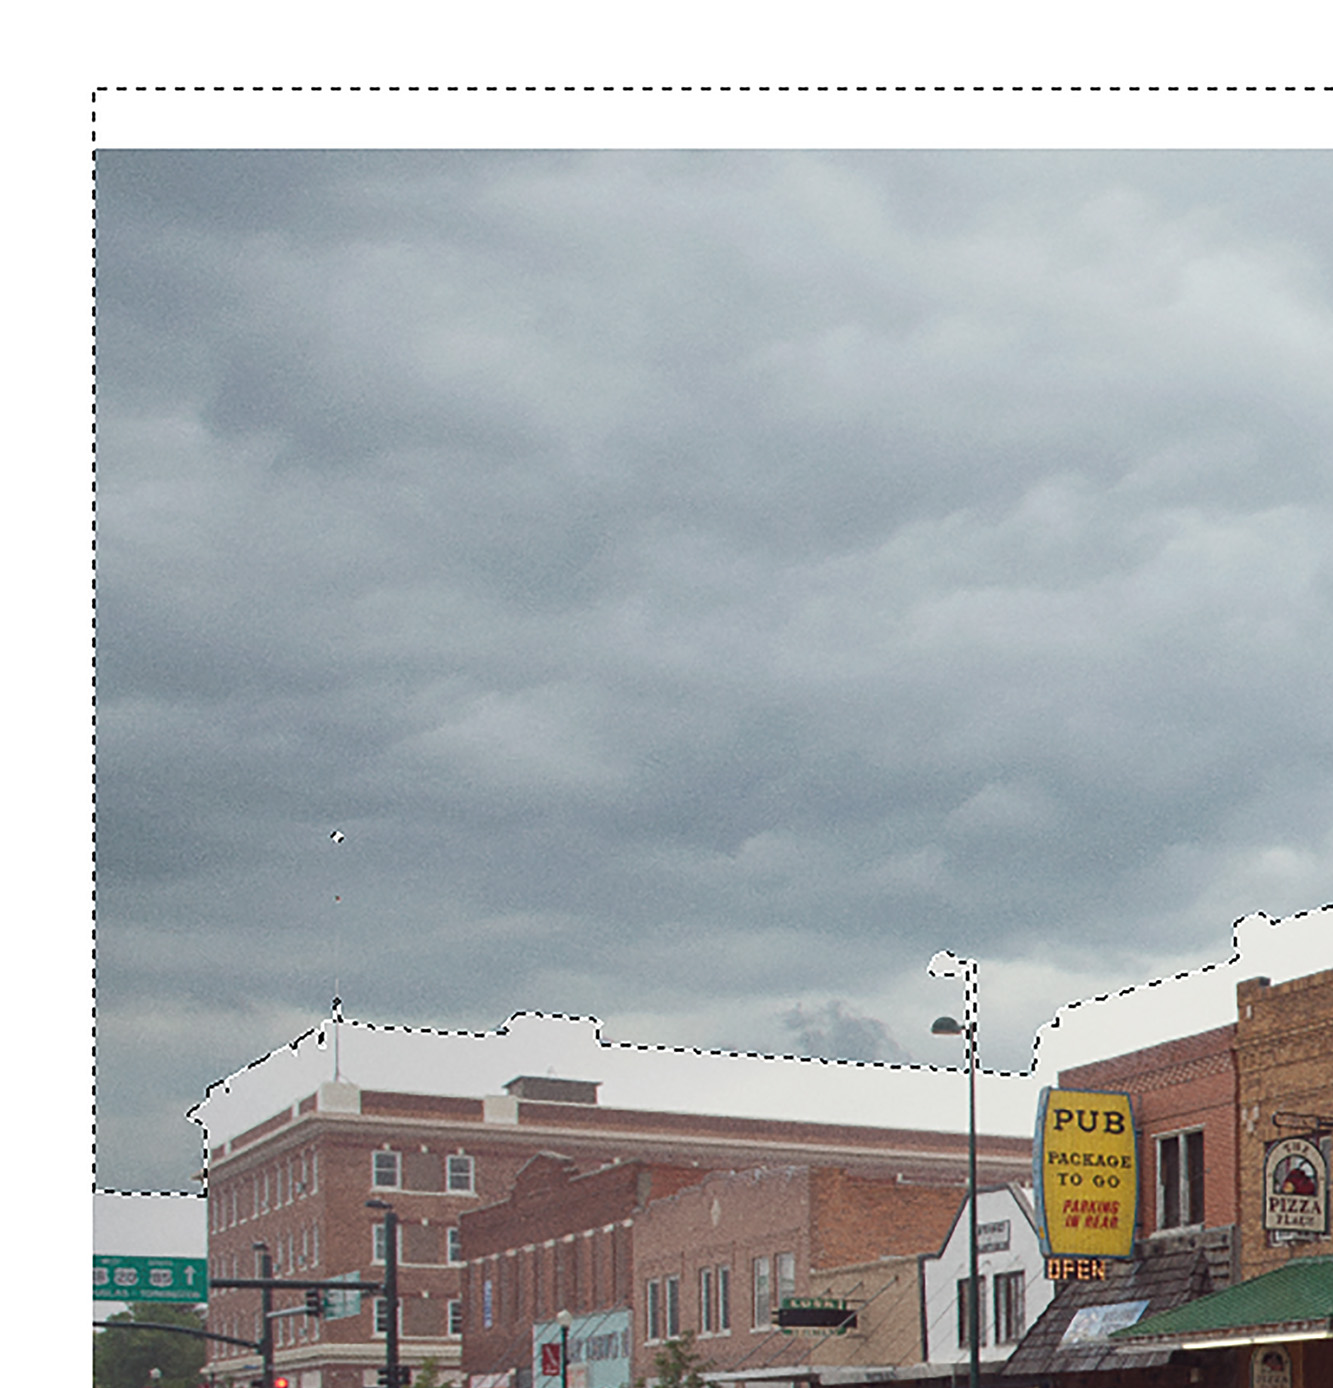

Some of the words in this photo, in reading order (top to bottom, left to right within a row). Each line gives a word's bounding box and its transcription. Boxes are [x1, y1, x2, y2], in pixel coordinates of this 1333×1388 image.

[1053, 1109, 1125, 1134] PUB
[1048, 1151, 1132, 1169] PACKAGE
[1057, 1172, 1083, 1186] TO
[1092, 1174, 1121, 1188] GO
[1063, 1199, 1120, 1214] PARKING
[1268, 1197, 1321, 1214] PIZZA
[1065, 1214, 1080, 1228] IN
[1085, 1215, 1119, 1229] REAR
[1276, 1213, 1315, 1226] PLACE
[1048, 1259, 1106, 1281] OPEN
